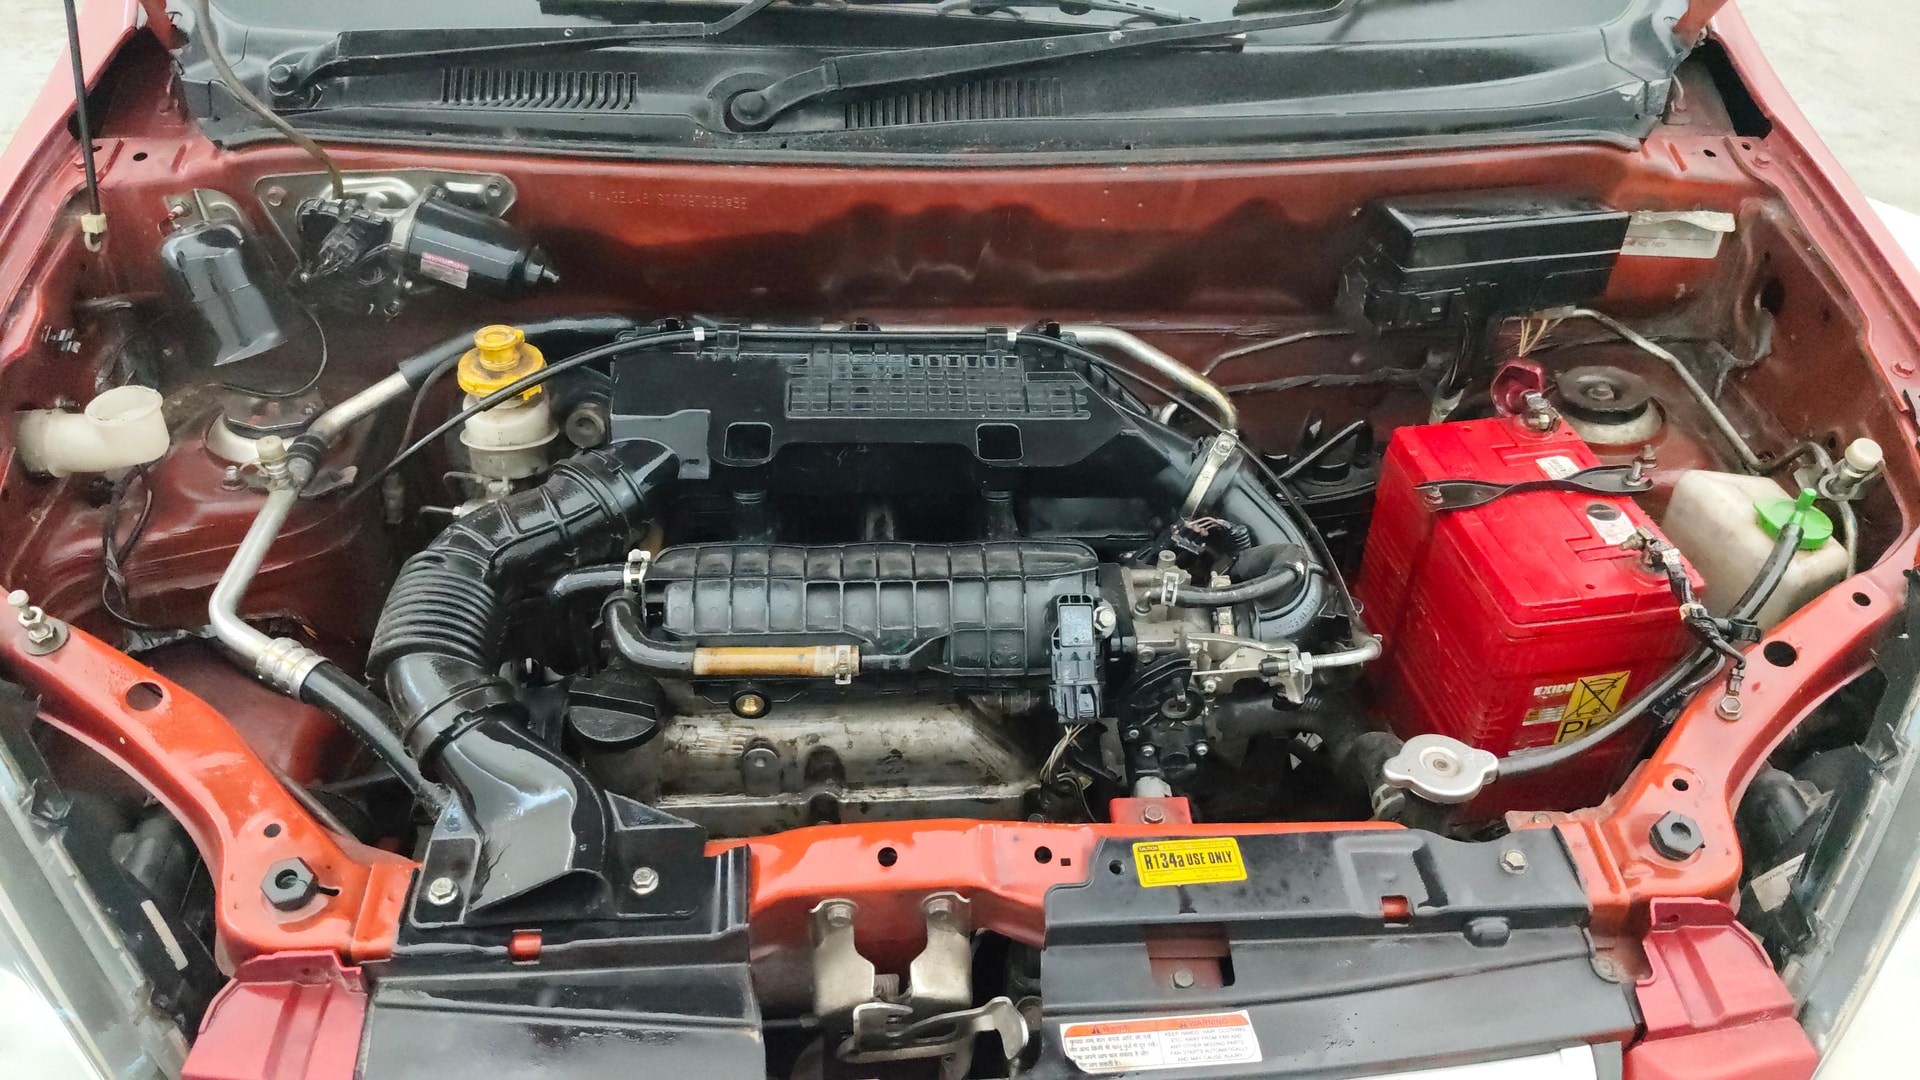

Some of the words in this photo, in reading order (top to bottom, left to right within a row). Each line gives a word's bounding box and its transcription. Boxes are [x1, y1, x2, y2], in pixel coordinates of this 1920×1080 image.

[1533, 682, 1575, 696] EXIDE
[1143, 853, 1185, 870] R134a
[1185, 852, 1206, 866] USE
[1207, 851, 1233, 864] ONLY
